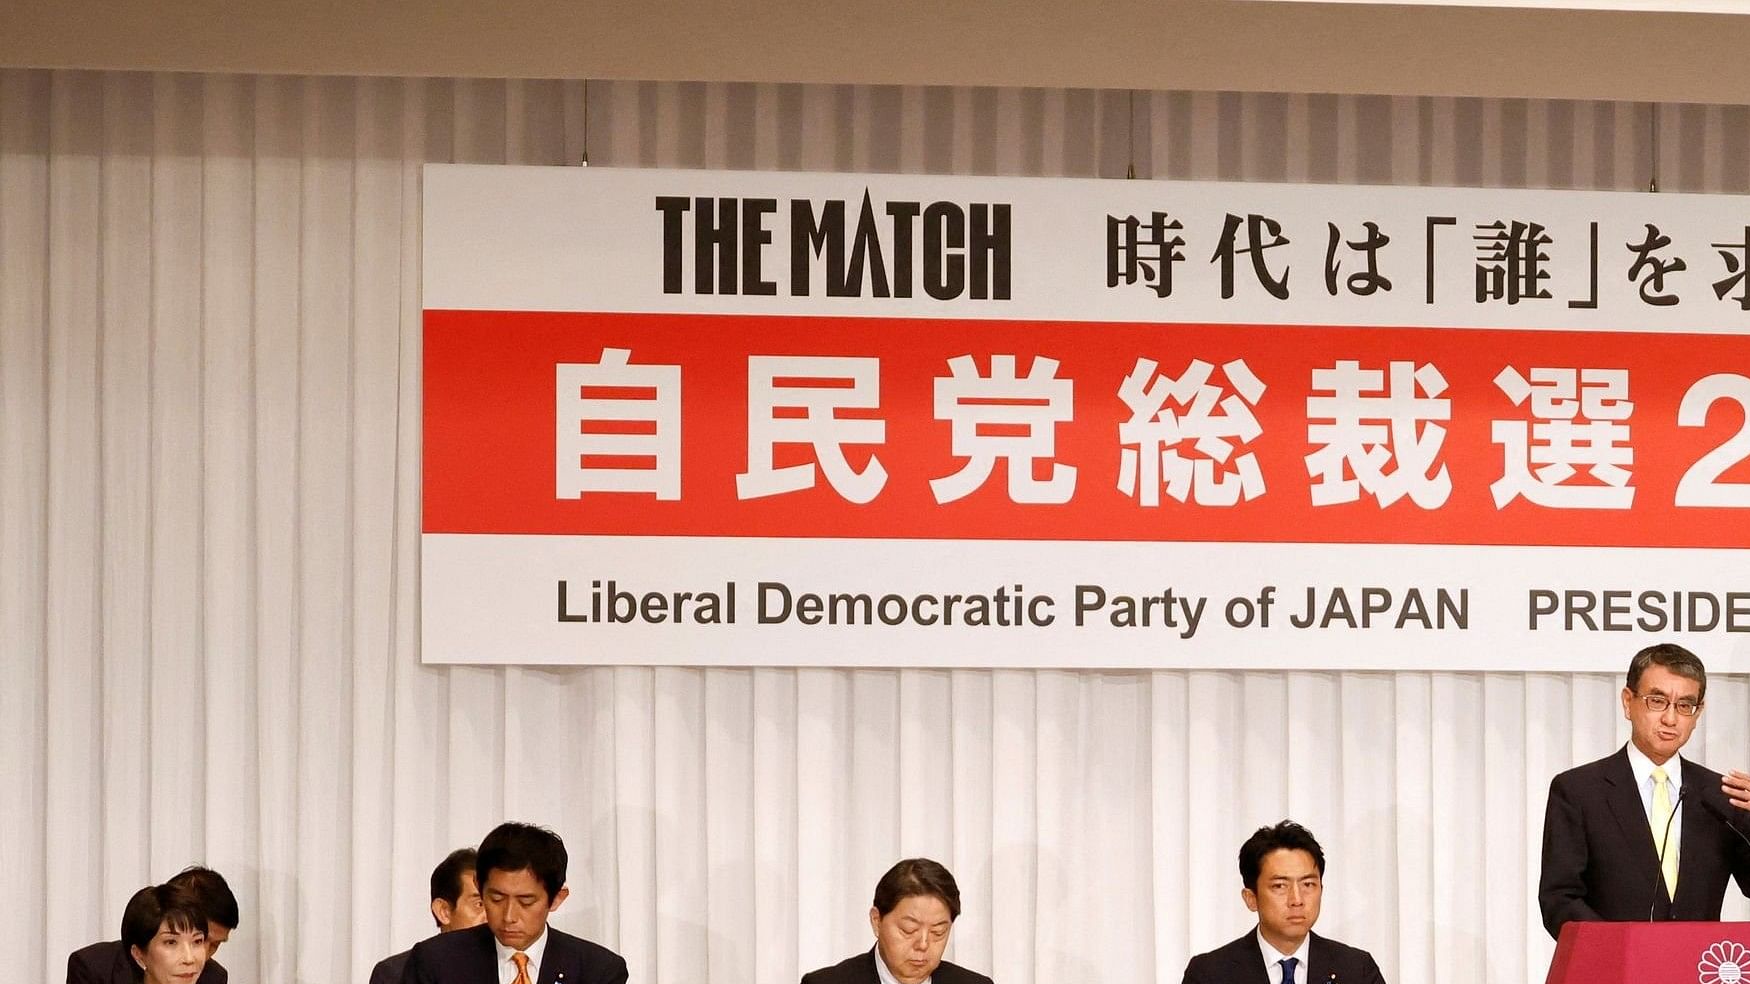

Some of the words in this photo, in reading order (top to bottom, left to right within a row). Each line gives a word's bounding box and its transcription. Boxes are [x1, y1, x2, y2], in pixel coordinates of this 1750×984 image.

[656, 195, 778, 297] THE
[790, 186, 1012, 301] MATCH
[557, 580, 736, 624] Liberal
[757, 581, 1056, 627] Democratic
[1075, 585, 1208, 640] Party
[1225, 586, 1276, 629] of
[1289, 587, 1469, 630] JAPAN
